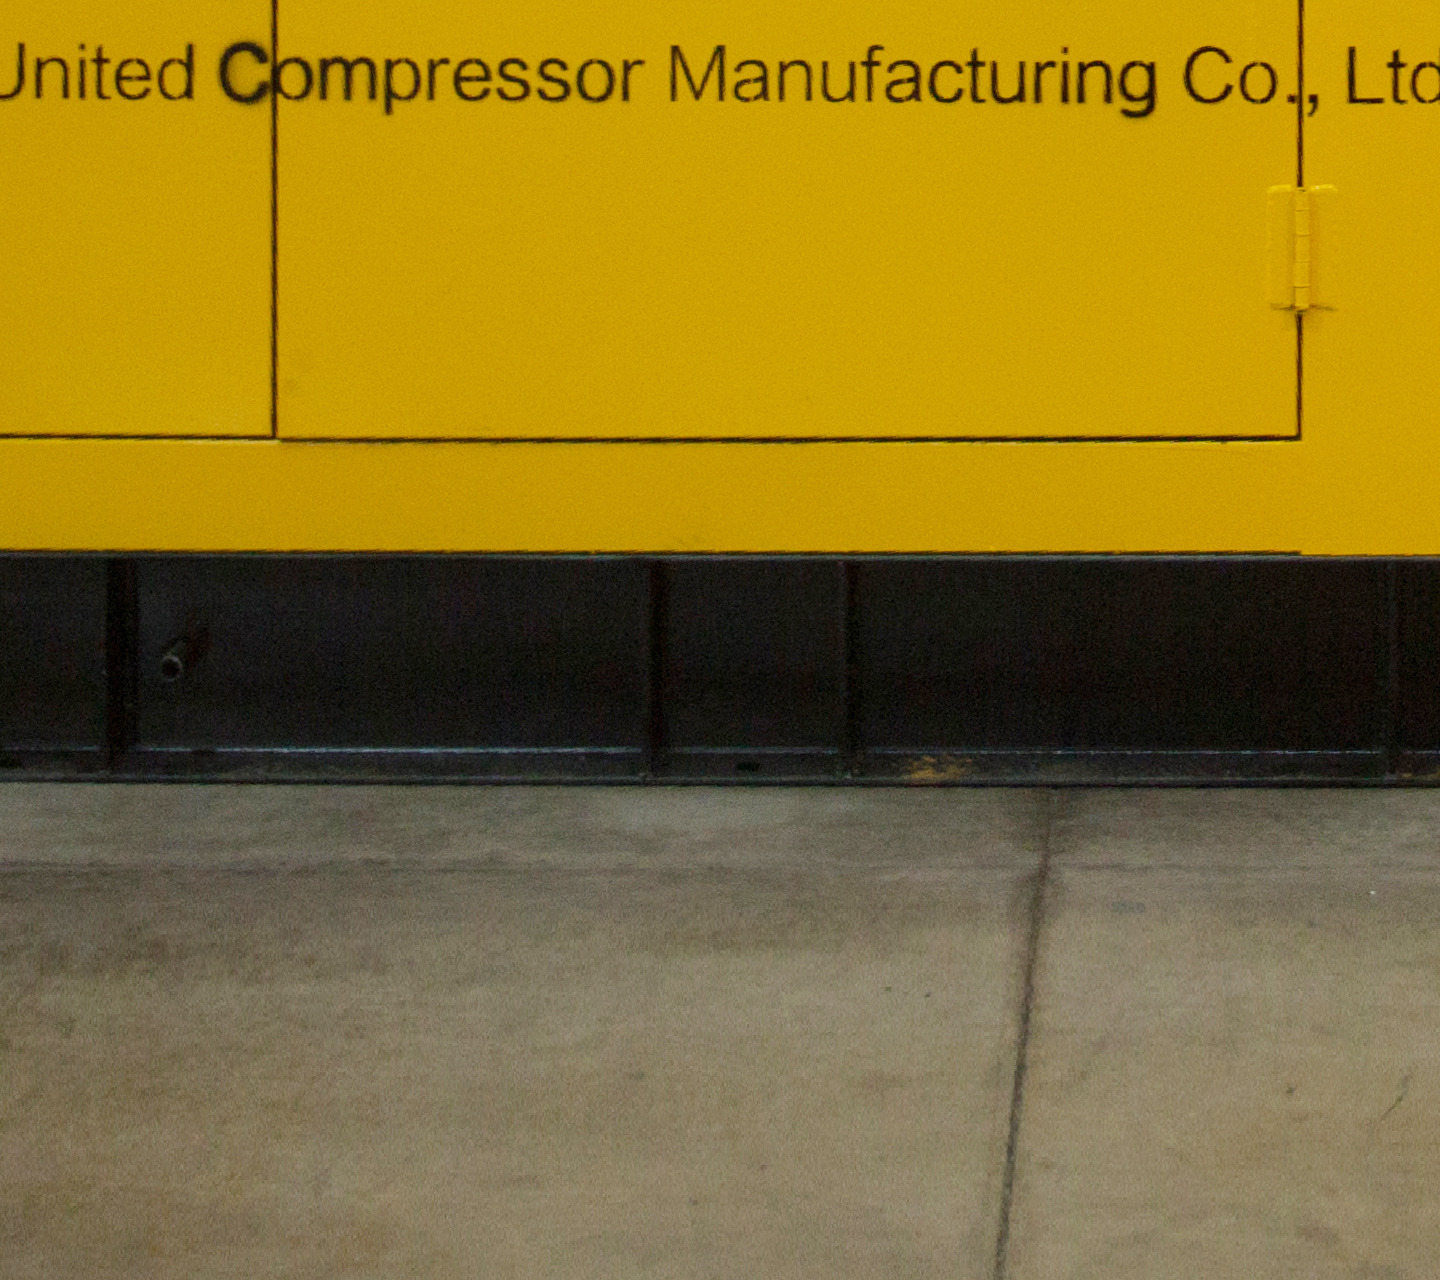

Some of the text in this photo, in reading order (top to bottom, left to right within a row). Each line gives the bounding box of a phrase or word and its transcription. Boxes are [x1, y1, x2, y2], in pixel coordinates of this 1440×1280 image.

[216, 42, 646, 116] Compressor
[668, 44, 1157, 119] Manufacturing
[1181, 46, 1320, 117] Co.,
